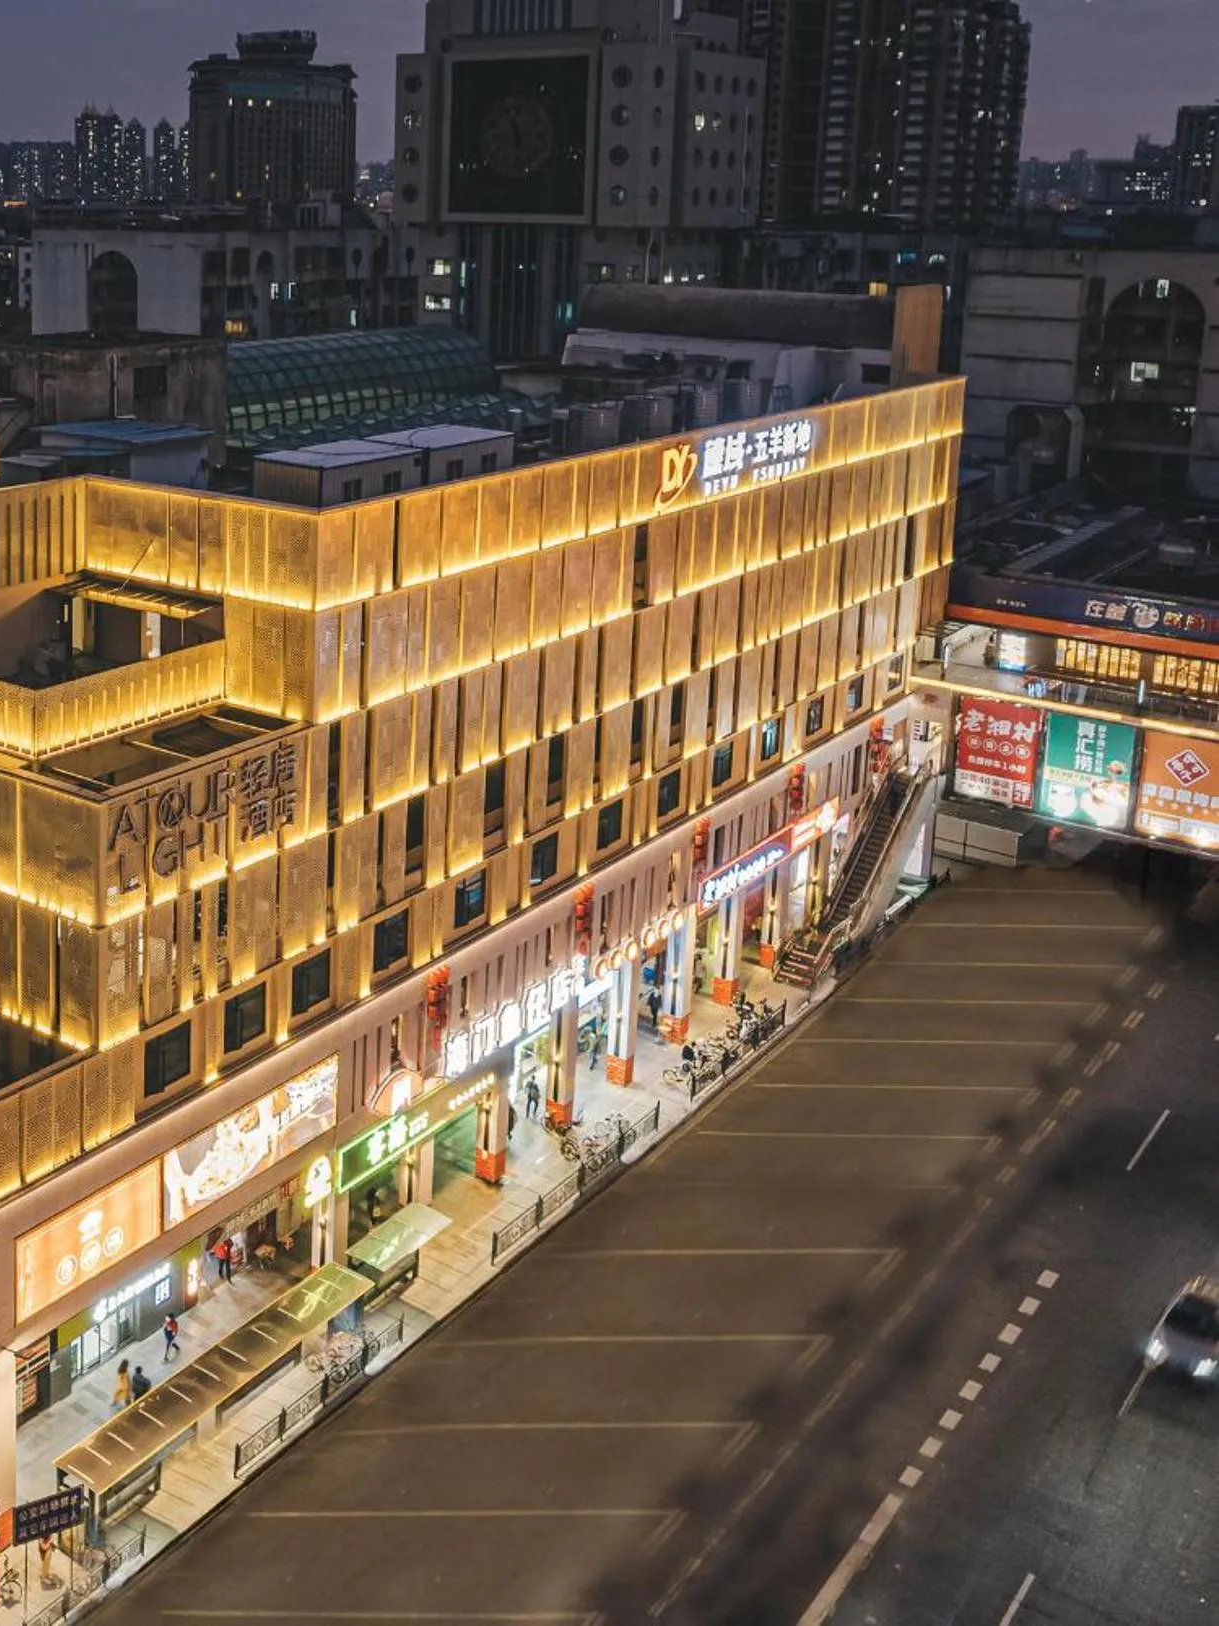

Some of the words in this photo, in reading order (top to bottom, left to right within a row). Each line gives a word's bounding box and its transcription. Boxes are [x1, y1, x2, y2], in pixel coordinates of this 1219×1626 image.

[110, 768, 237, 853] ATOUR
[240, 789, 296, 843] 酒店
[118, 812, 229, 895] LIGHT
